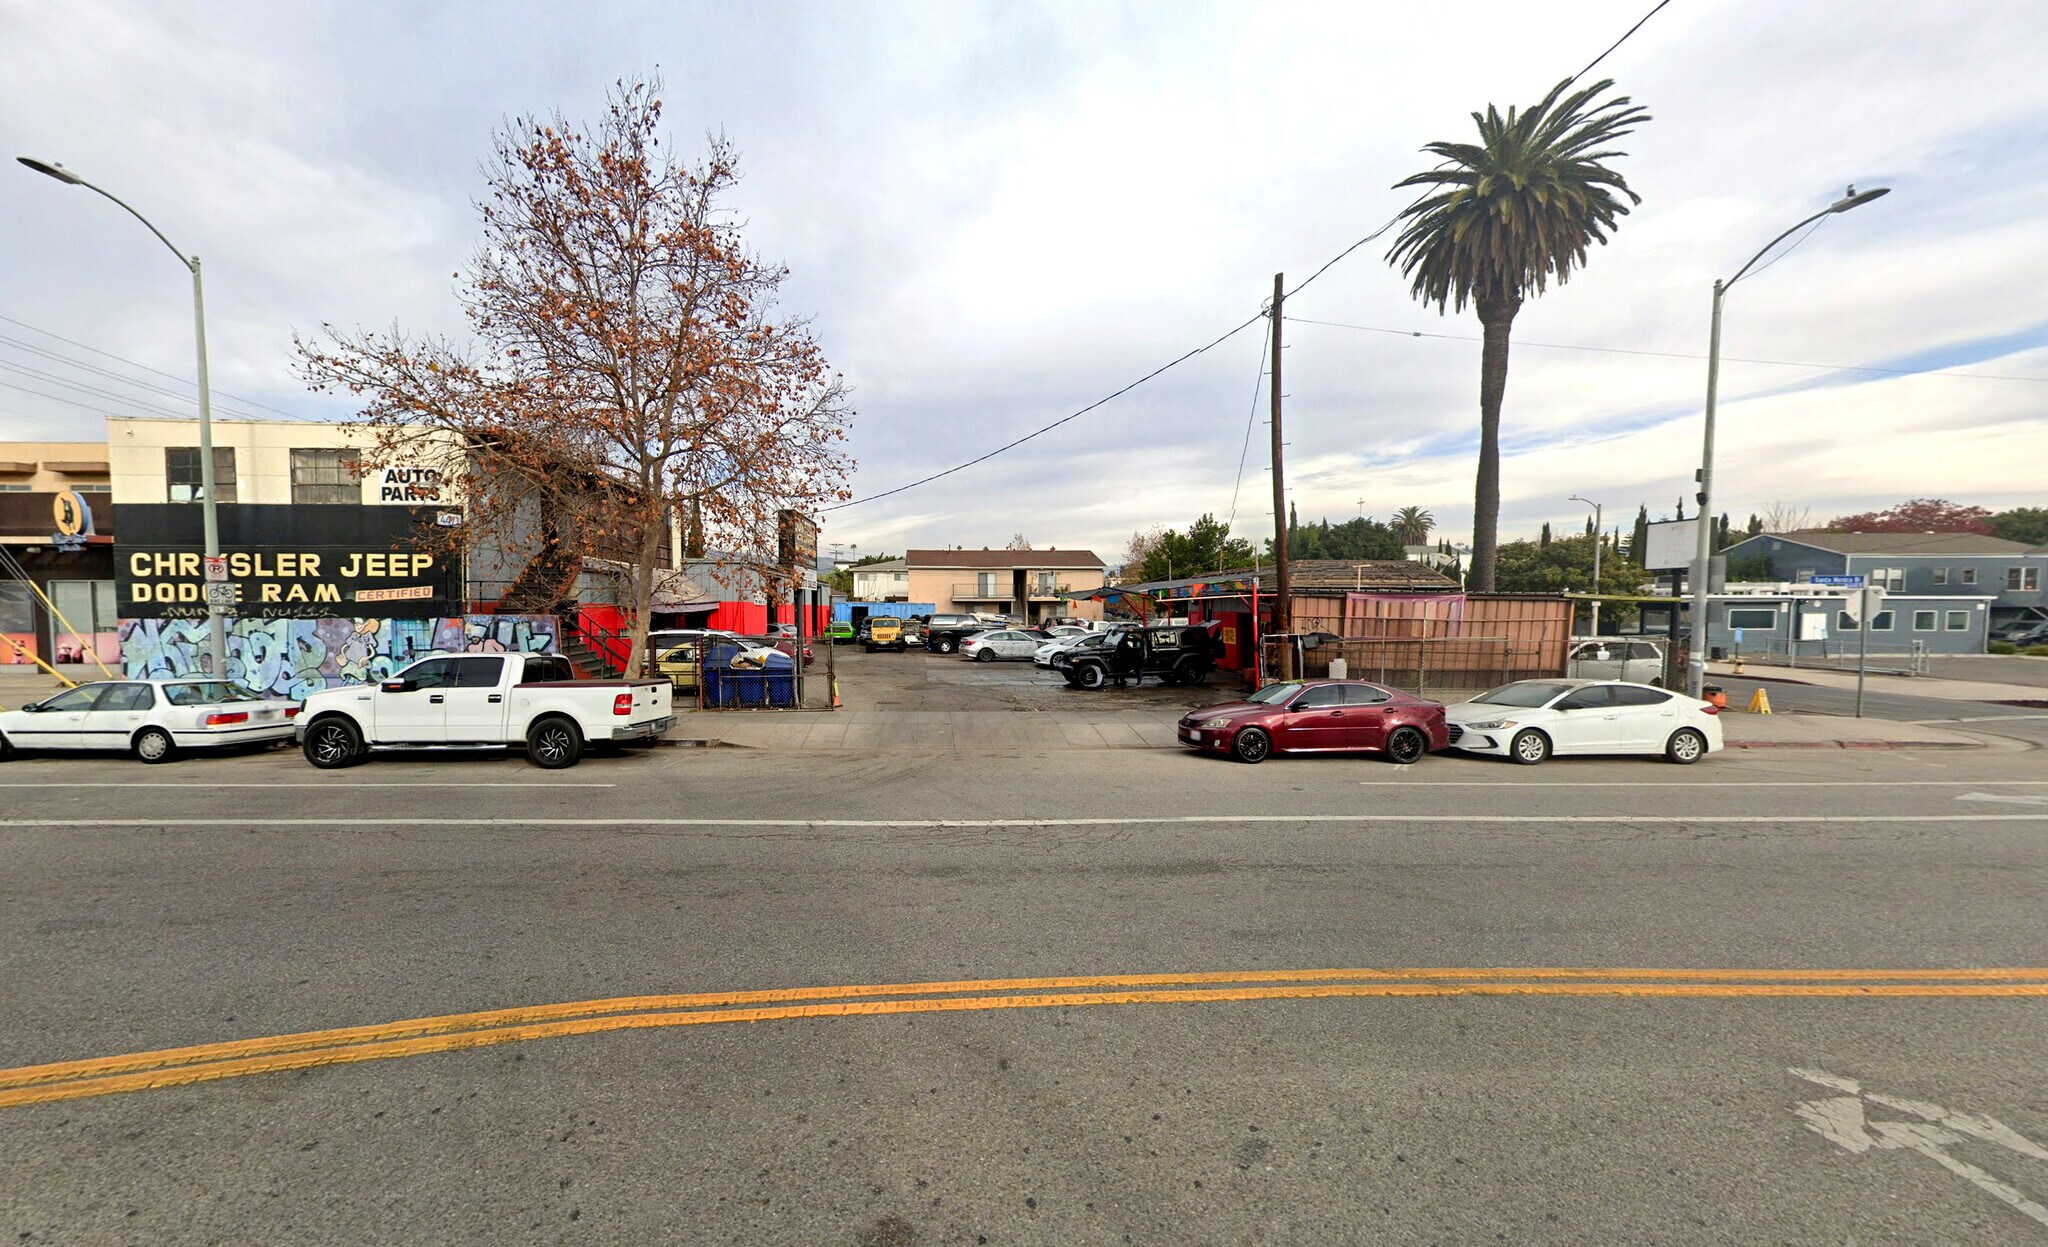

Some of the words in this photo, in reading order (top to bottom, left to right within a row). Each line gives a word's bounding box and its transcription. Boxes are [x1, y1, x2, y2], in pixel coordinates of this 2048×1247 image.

[385, 469, 441, 484] AUTO
[130, 552, 321, 577] CHRSLER
[340, 553, 433, 577] JEEP
[261, 583, 341, 602] RAM
[357, 587, 432, 601] CERTIFIED
